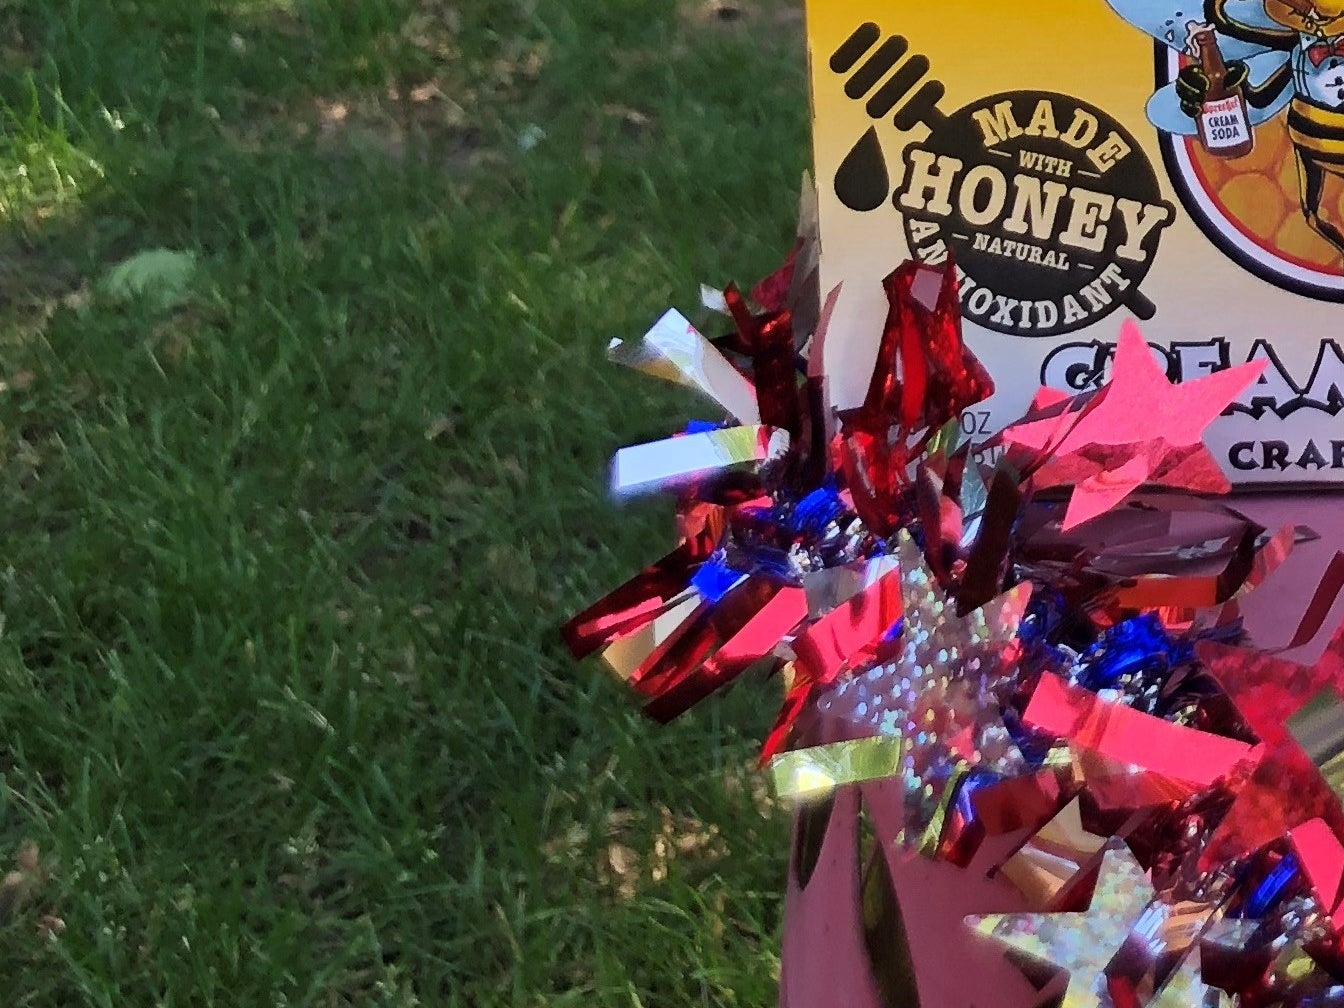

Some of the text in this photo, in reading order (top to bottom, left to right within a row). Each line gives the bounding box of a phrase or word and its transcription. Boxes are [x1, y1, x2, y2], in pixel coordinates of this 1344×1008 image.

[972, 99, 1132, 173] MADE
[1208, 114, 1240, 128] CREAM
[1211, 126, 1241, 141] SODA
[1019, 149, 1074, 178] WITH
[900, 149, 1169, 262] HONEY
[973, 232, 1070, 271] NATURAL
[909, 218, 1131, 330] ANIOXIDANT
[961, 411, 992, 435] OZ
